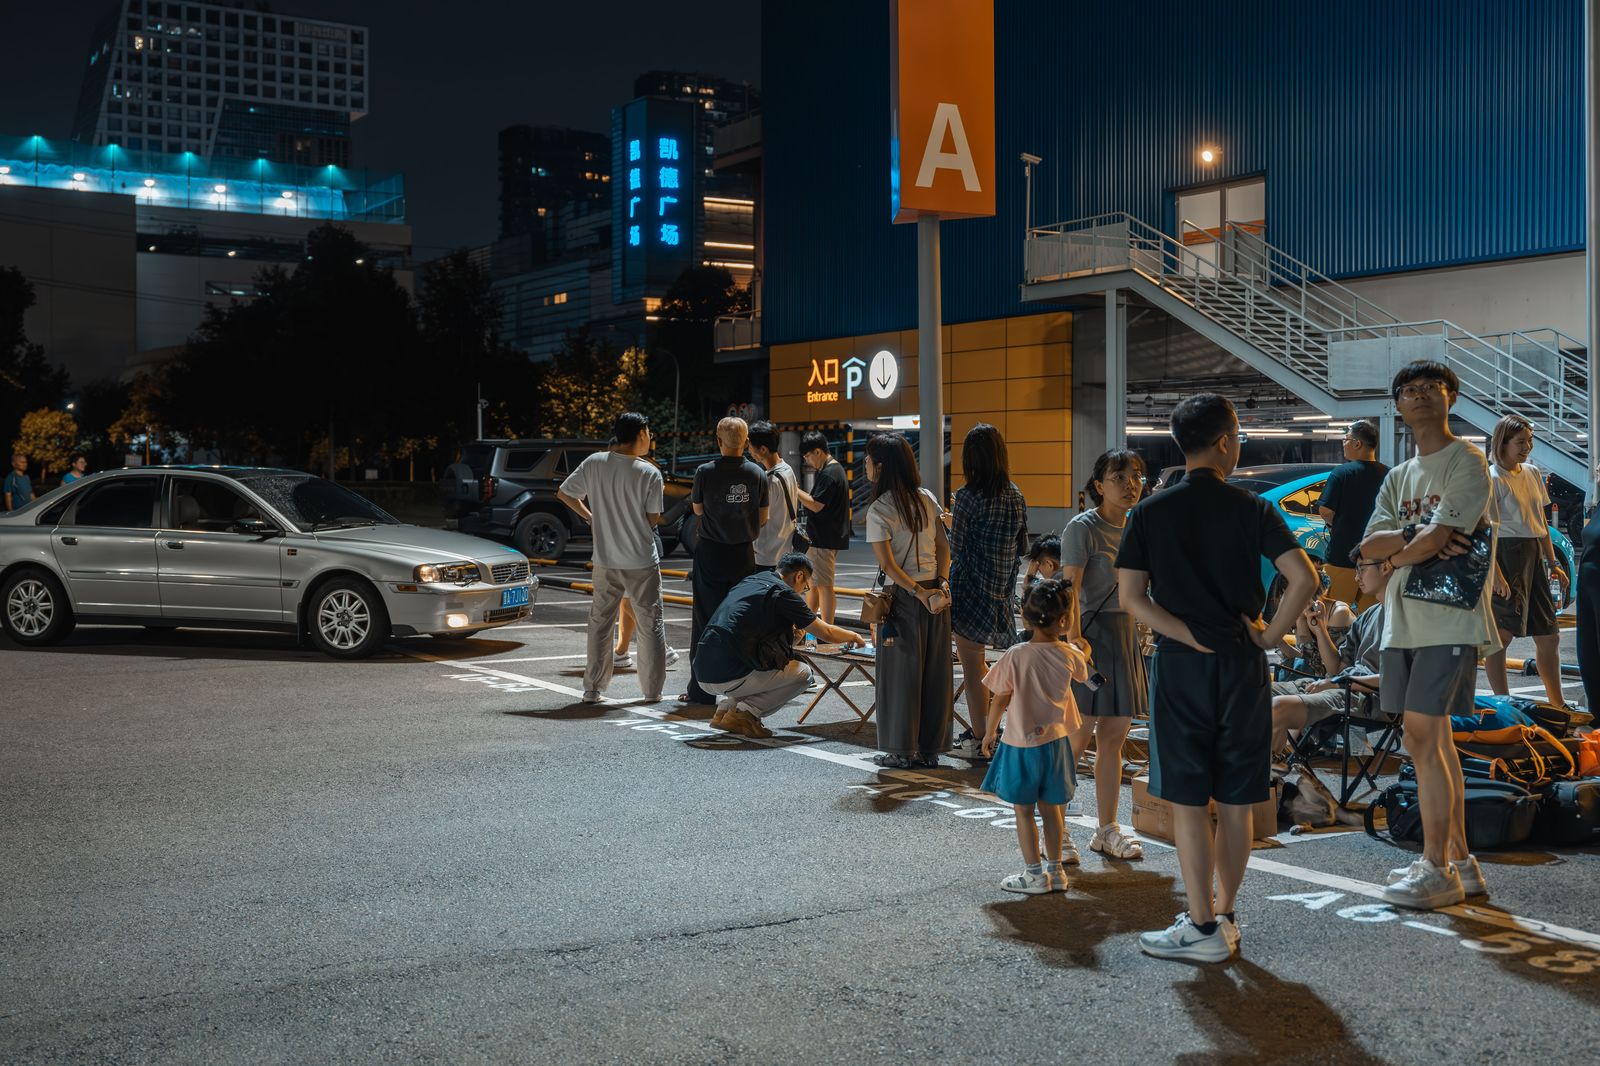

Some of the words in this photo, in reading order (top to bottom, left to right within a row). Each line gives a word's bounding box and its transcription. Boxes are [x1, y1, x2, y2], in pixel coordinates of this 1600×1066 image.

[915, 103, 982, 192] A
[658, 137, 679, 246] 凯德广场
[807, 358, 839, 387] 入口
[846, 366, 863, 400] P
[807, 391, 839, 403] Entrance
[725, 493, 751, 504] EOS
[1264, 891, 1600, 974] A6-58
